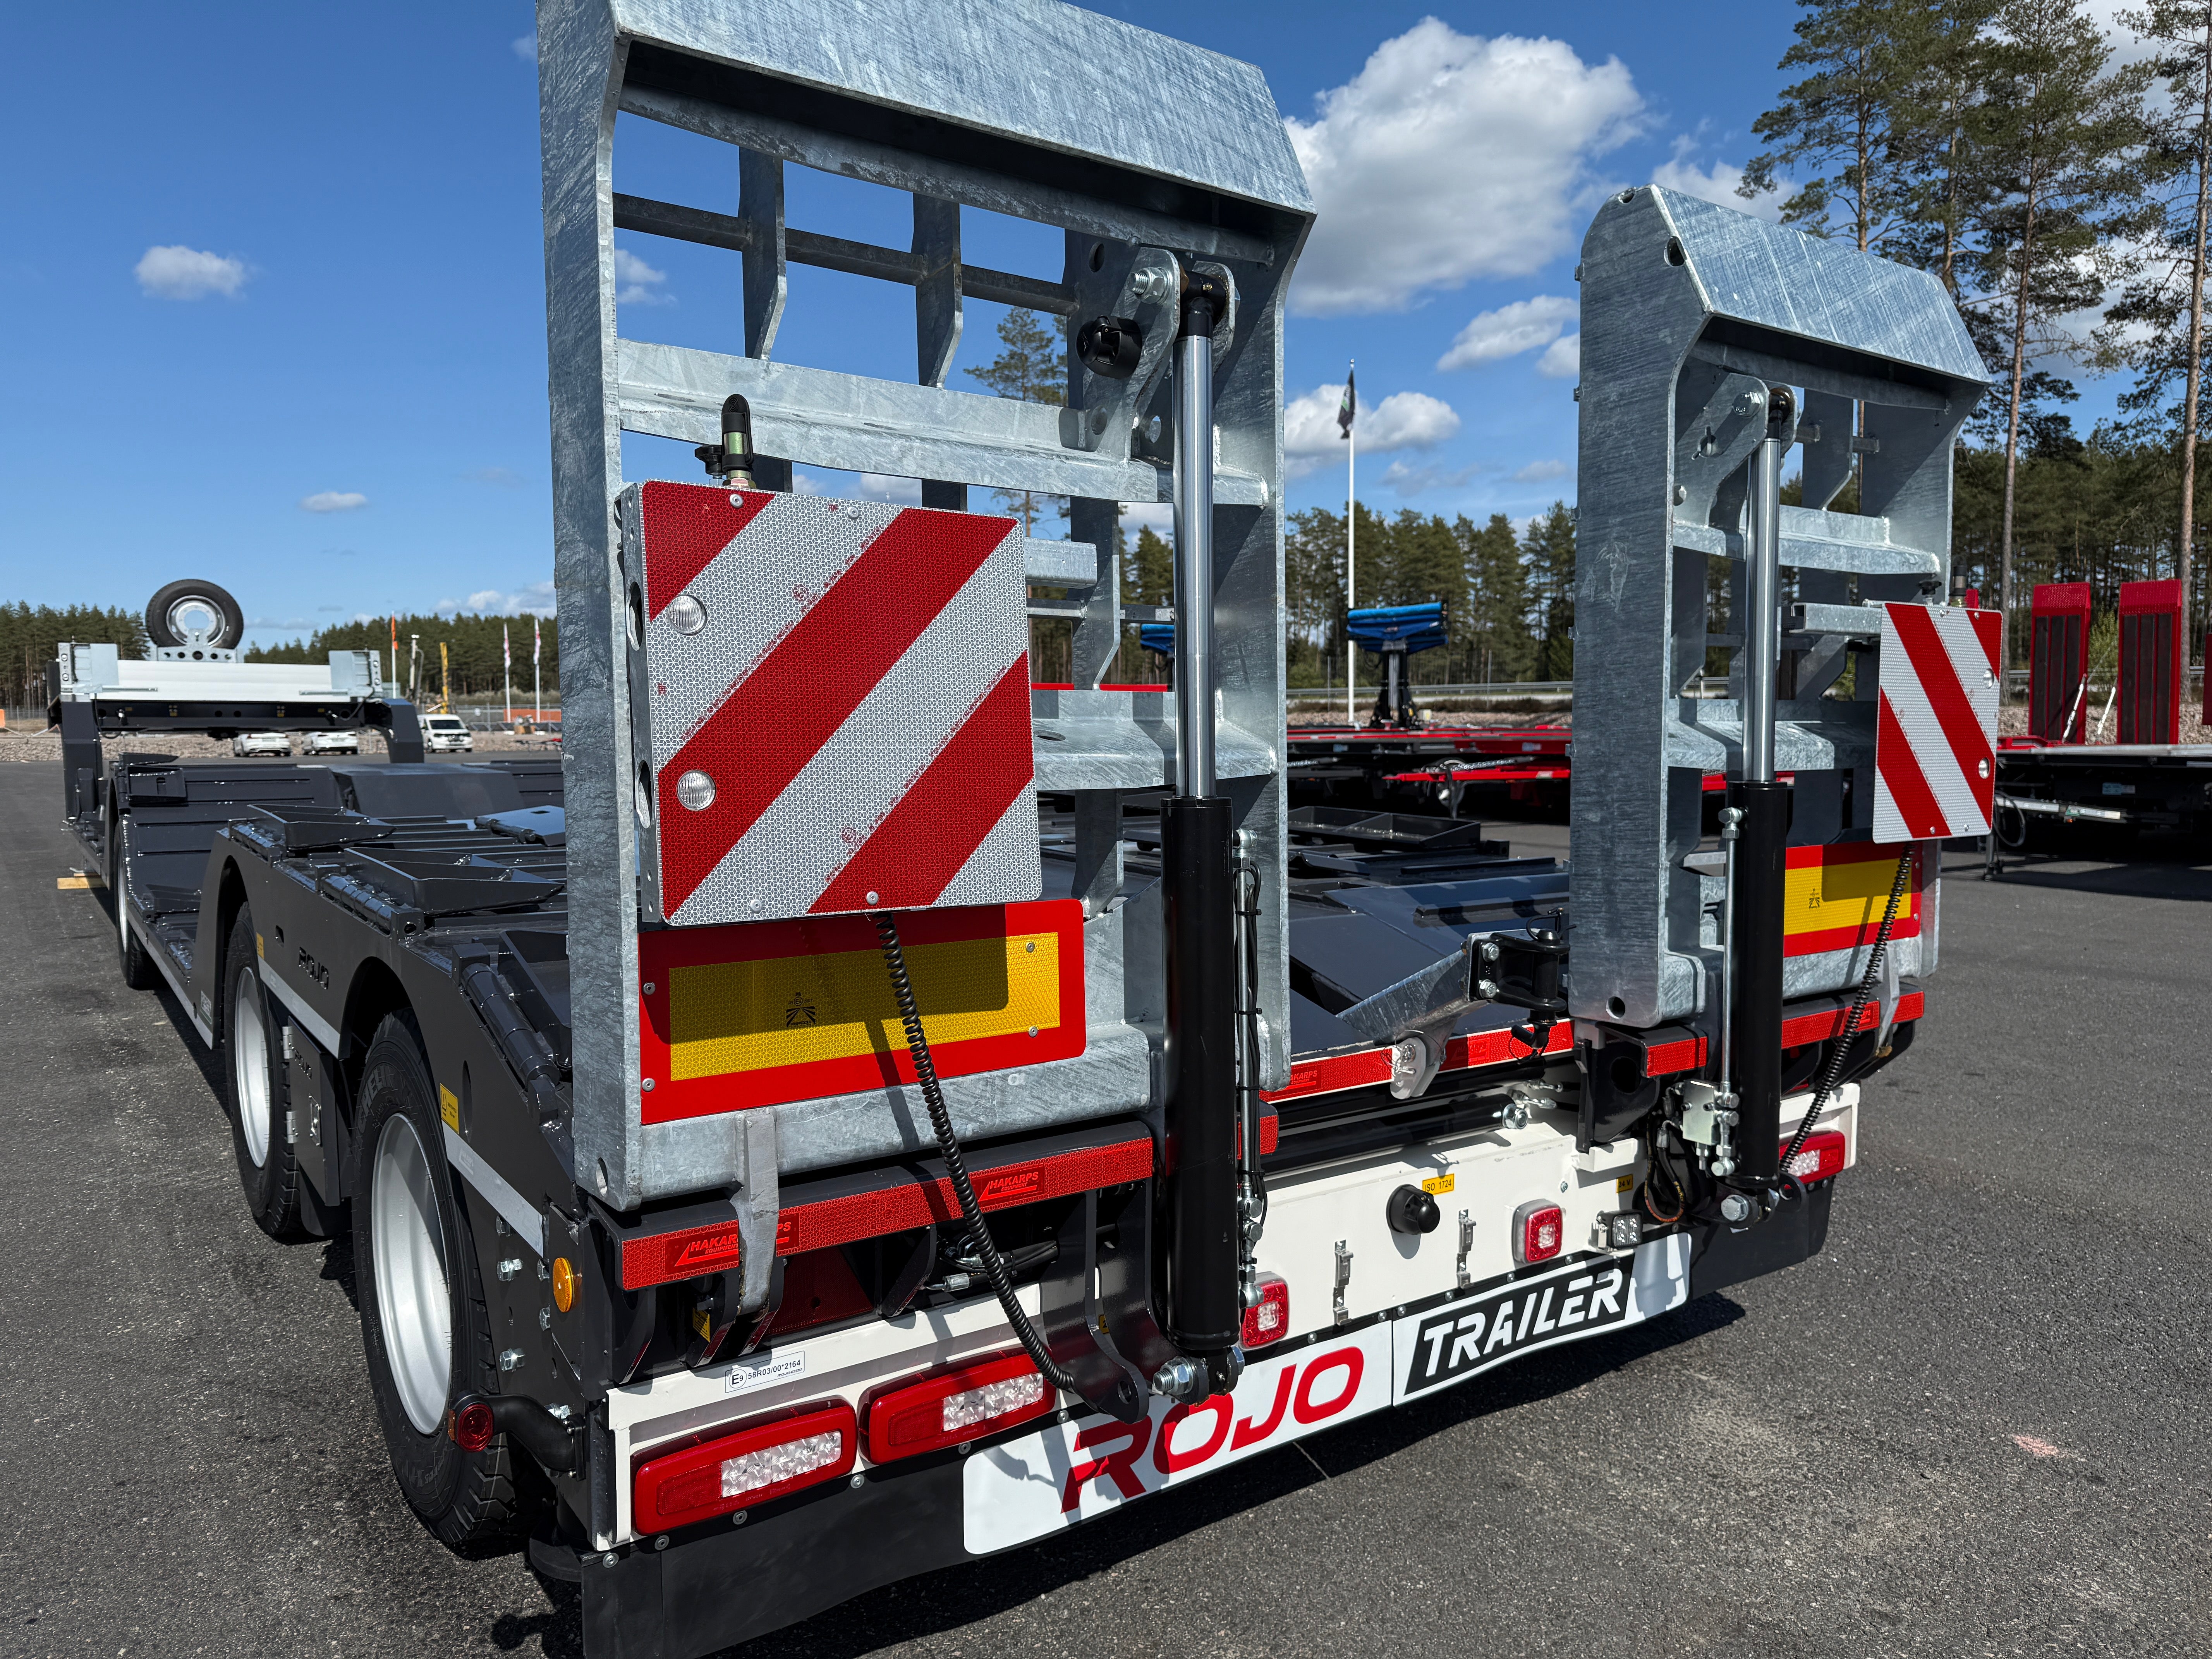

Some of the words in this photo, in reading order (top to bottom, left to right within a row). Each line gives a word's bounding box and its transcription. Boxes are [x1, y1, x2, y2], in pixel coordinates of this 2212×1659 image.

[1291, 1070, 1317, 1081] AKARPS
[990, 1171, 1039, 1189] HAKARPS
[1001, 1182, 1028, 1192] EQUIPMENT
[1425, 1183, 1435, 1192] ISO
[1439, 1179, 1451, 1189] 1724
[1424, 1268, 1623, 1377] TRAILER
[1060, 1346, 1364, 1514] ROJO
